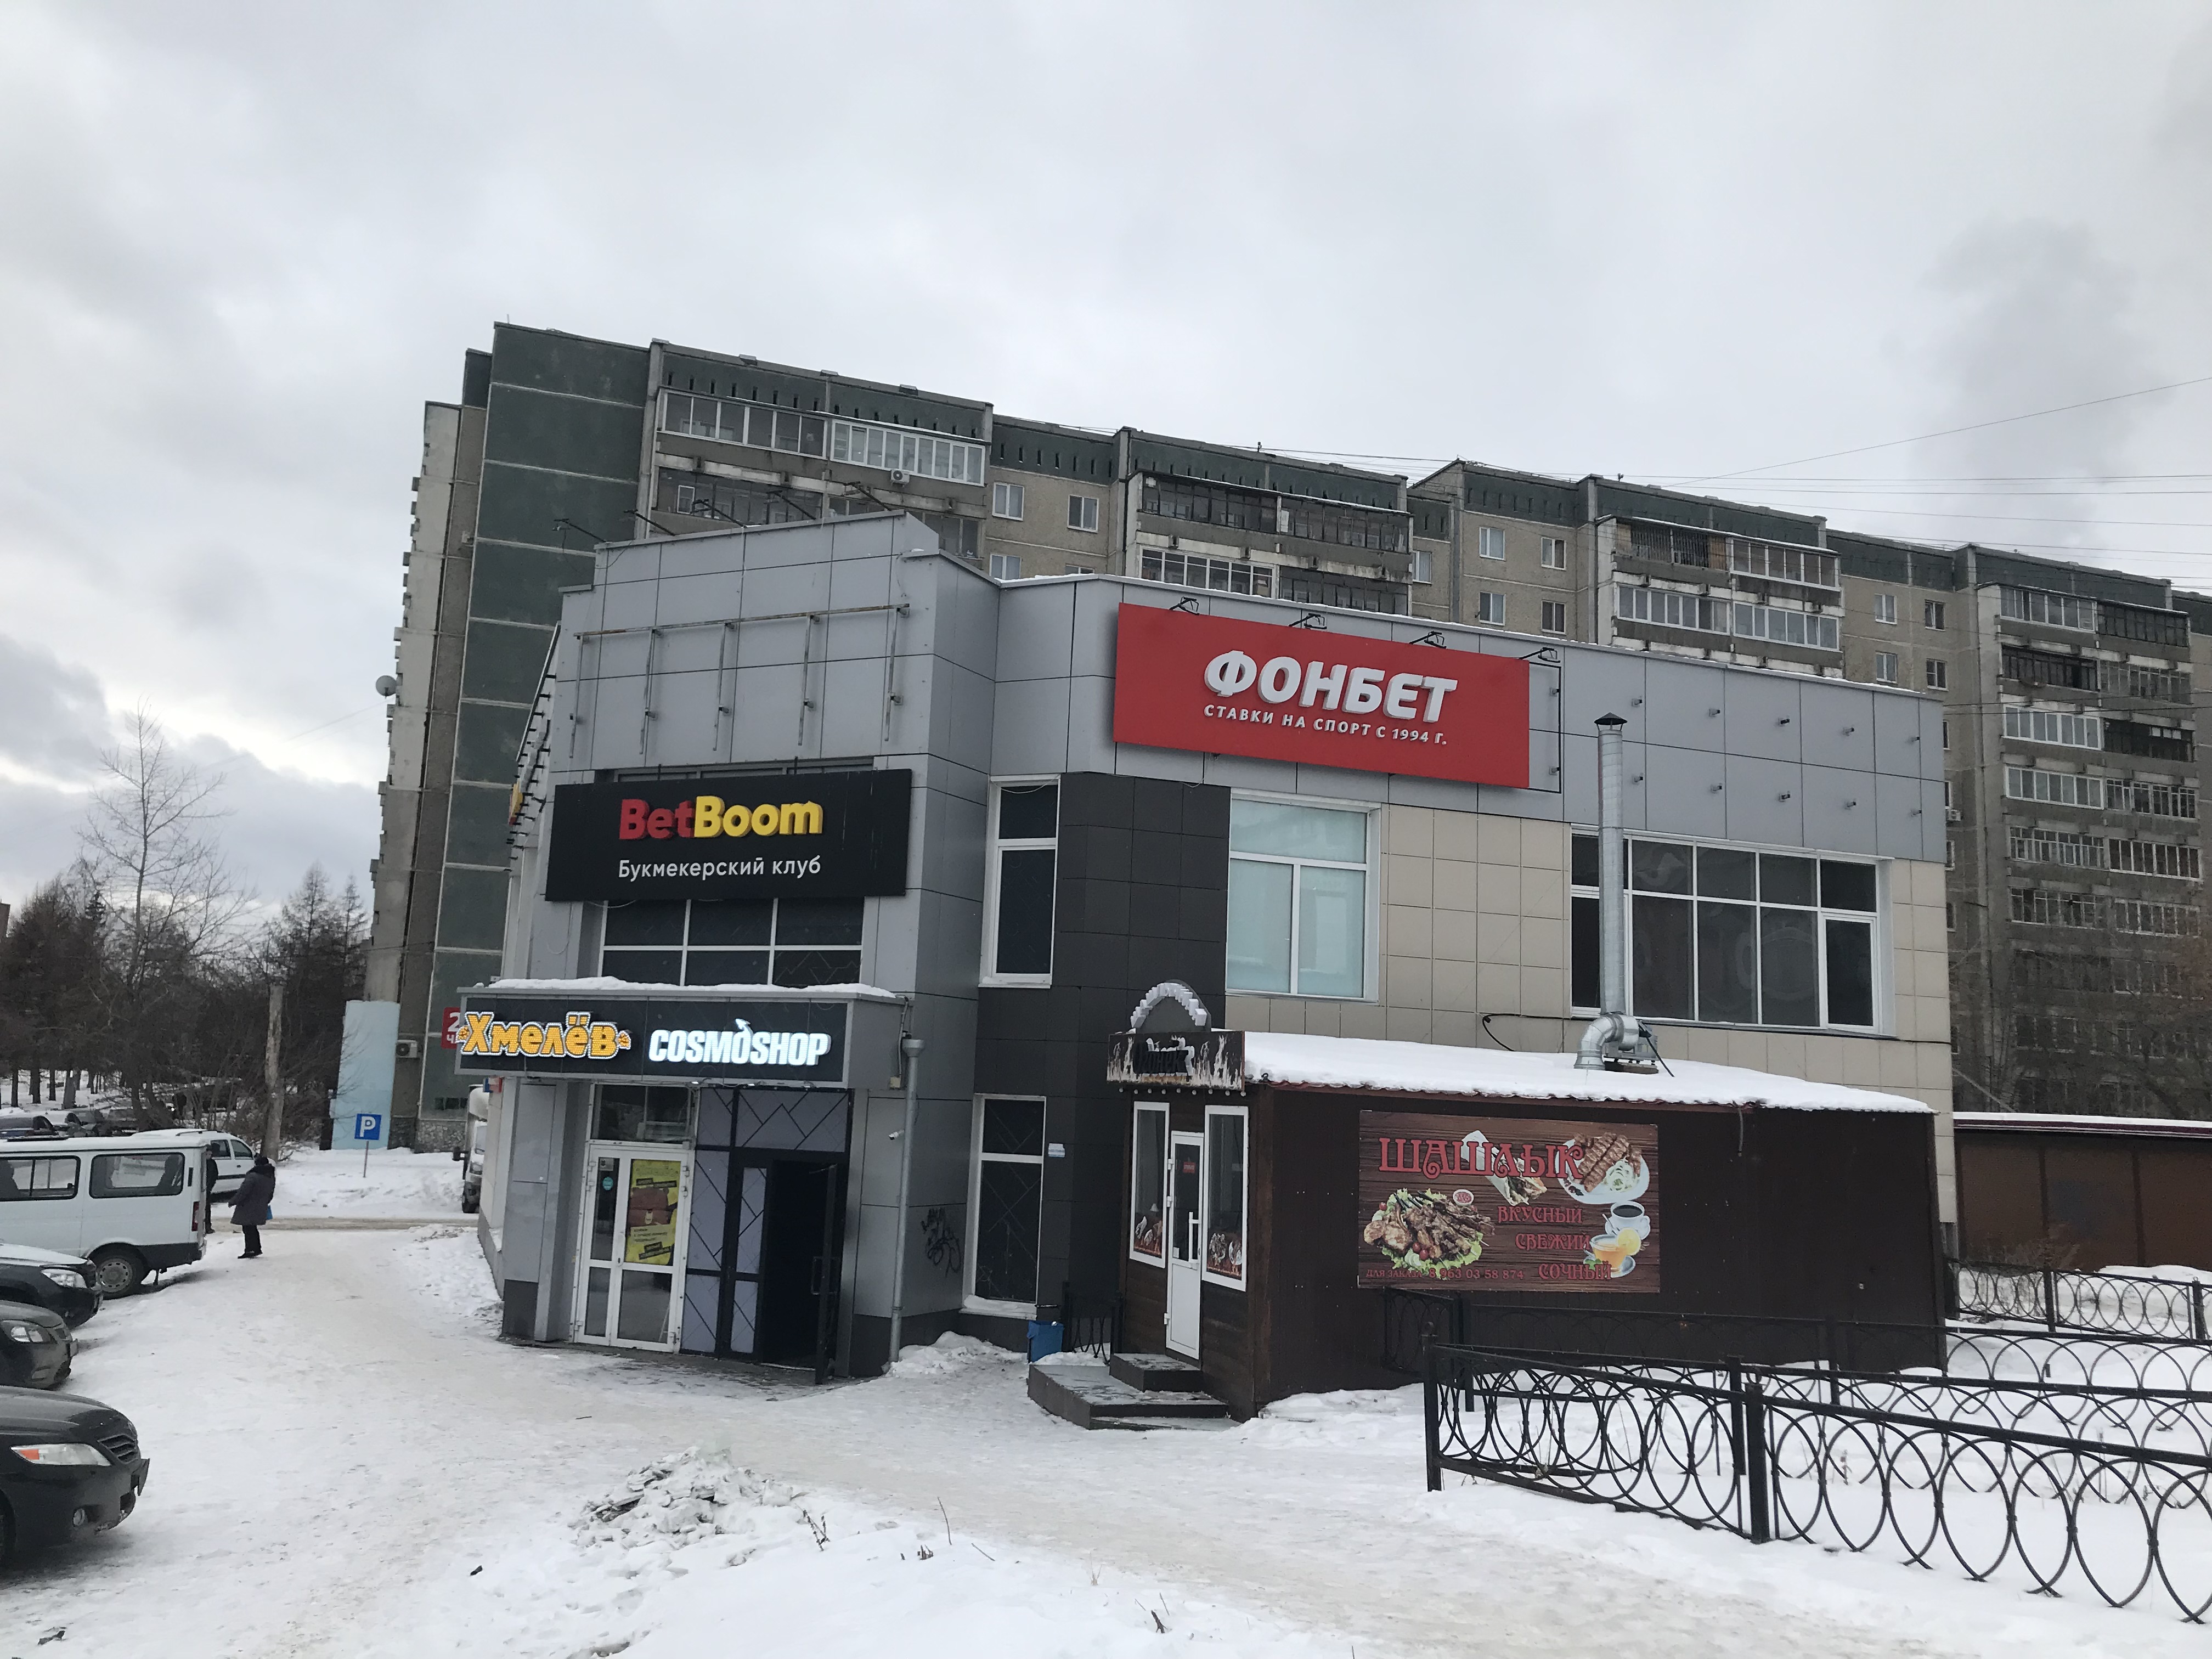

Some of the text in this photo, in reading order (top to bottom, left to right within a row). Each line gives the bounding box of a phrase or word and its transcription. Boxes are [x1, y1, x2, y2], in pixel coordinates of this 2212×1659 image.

[1204, 650, 1458, 723] ФОНБЕТ
[1204, 704, 1274, 725] СТАВКИ
[1281, 714, 1306, 728] НА
[1313, 718, 1372, 736] СПОРТ
[1375, 726, 1386, 738] С
[1392, 729, 1429, 743] 1994
[619, 795, 823, 840] BetBoom
[618, 855, 821, 882] Букмекерский клуб
[648, 1022, 831, 1066] COSMOSHOP
[359, 1116, 376, 1137] P
[1378, 1137, 1584, 1180] ШАШЛЫК
[1497, 1205, 1583, 1224] ВКУСНЫЙ
[1515, 1232, 1591, 1251] СВЕЖИЙ
[1365, 1269, 1385, 1278] ДЛЯ
[1427, 1267, 1436, 1279] 8
[1439, 1268, 1463, 1279] 963
[1465, 1268, 1481, 1279] 03
[1484, 1268, 1499, 1279] 58
[1502, 1269, 1525, 1280] 874
[1537, 1261, 1612, 1280] СОЧНЫЙ
